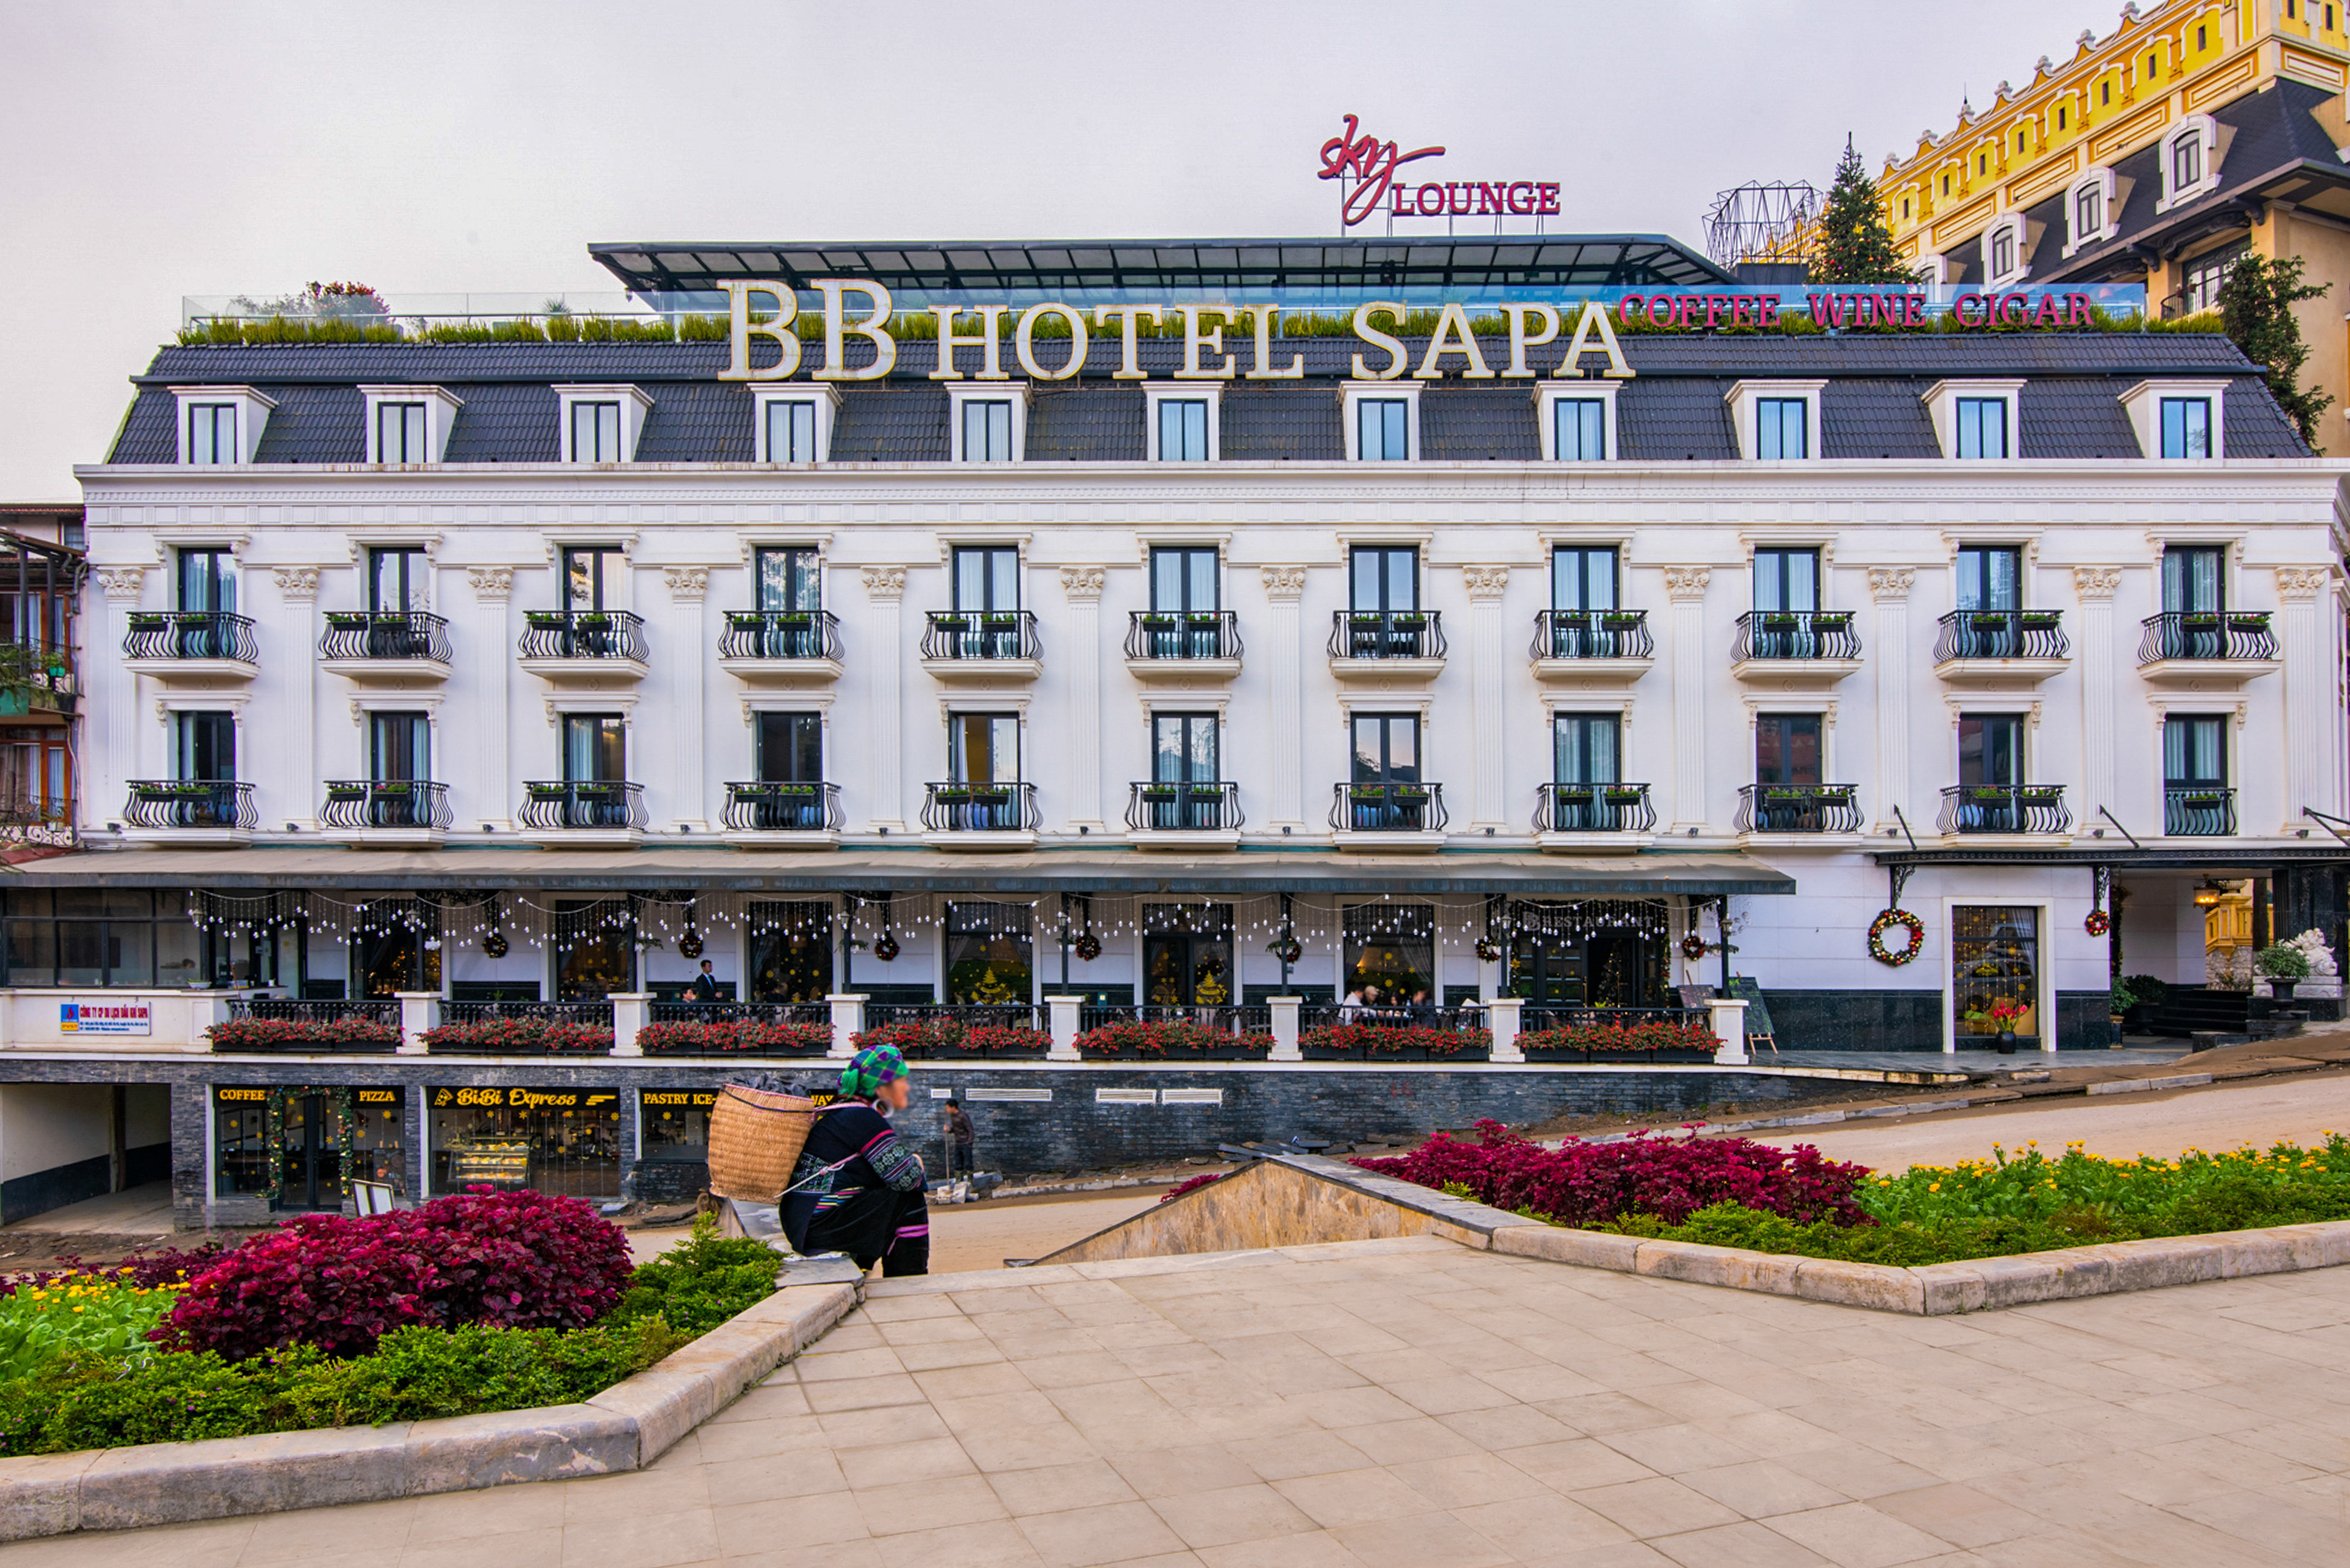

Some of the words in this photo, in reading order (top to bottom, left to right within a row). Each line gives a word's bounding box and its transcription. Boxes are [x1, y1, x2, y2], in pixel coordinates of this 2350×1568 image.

[1391, 182, 1561, 216] LOUNGE
[1619, 293, 1781, 328] COFFEE
[1807, 293, 1927, 328] WINE
[1953, 293, 2095, 327] CIGAR
[716, 279, 897, 381] BB
[927, 302, 1303, 380] HOTEL
[1351, 300, 1637, 380] SAPA
[219, 1089, 266, 1100] COFFEE
[359, 1090, 396, 1102] PIZZA
[456, 1088, 503, 1106] BiBi
[509, 1088, 577, 1109] Express
[643, 1093, 689, 1104] PASTRY
